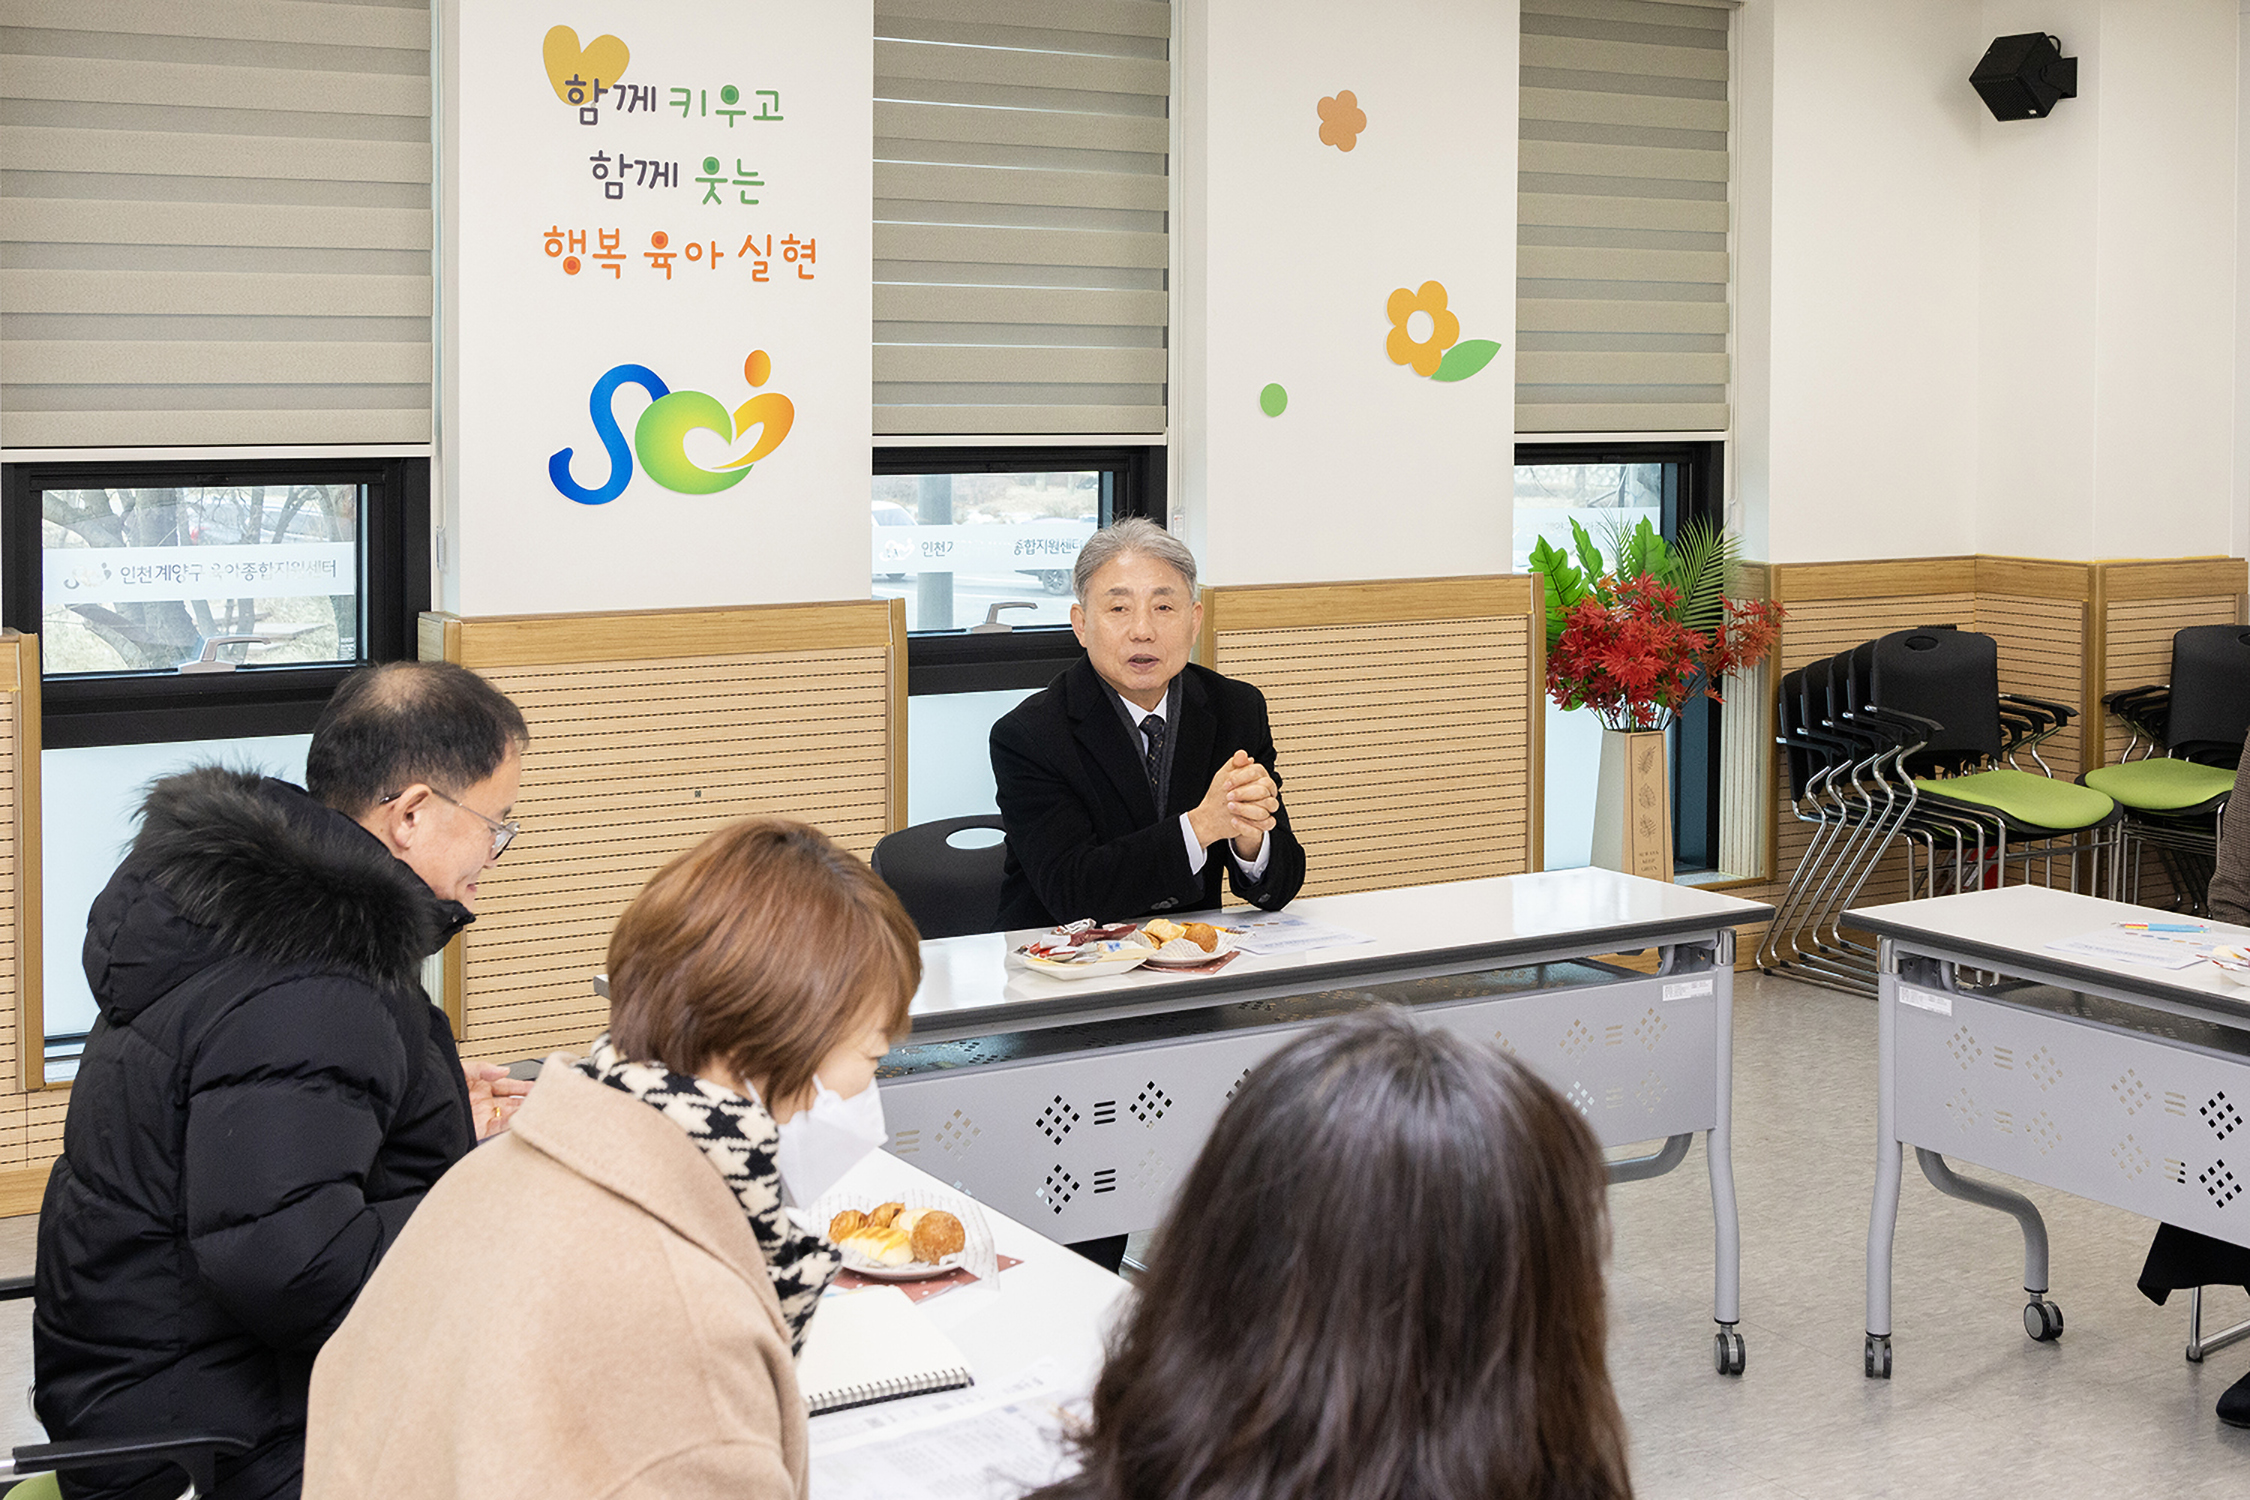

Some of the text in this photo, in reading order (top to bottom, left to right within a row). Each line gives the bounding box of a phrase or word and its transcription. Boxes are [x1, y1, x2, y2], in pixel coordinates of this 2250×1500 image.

[565, 74, 784, 128] 함께 키우고
[590, 150, 765, 205] 함께 웃는
[544, 225, 816, 282] 행복 육아 실현
[120, 563, 205, 585] 인천계양구
